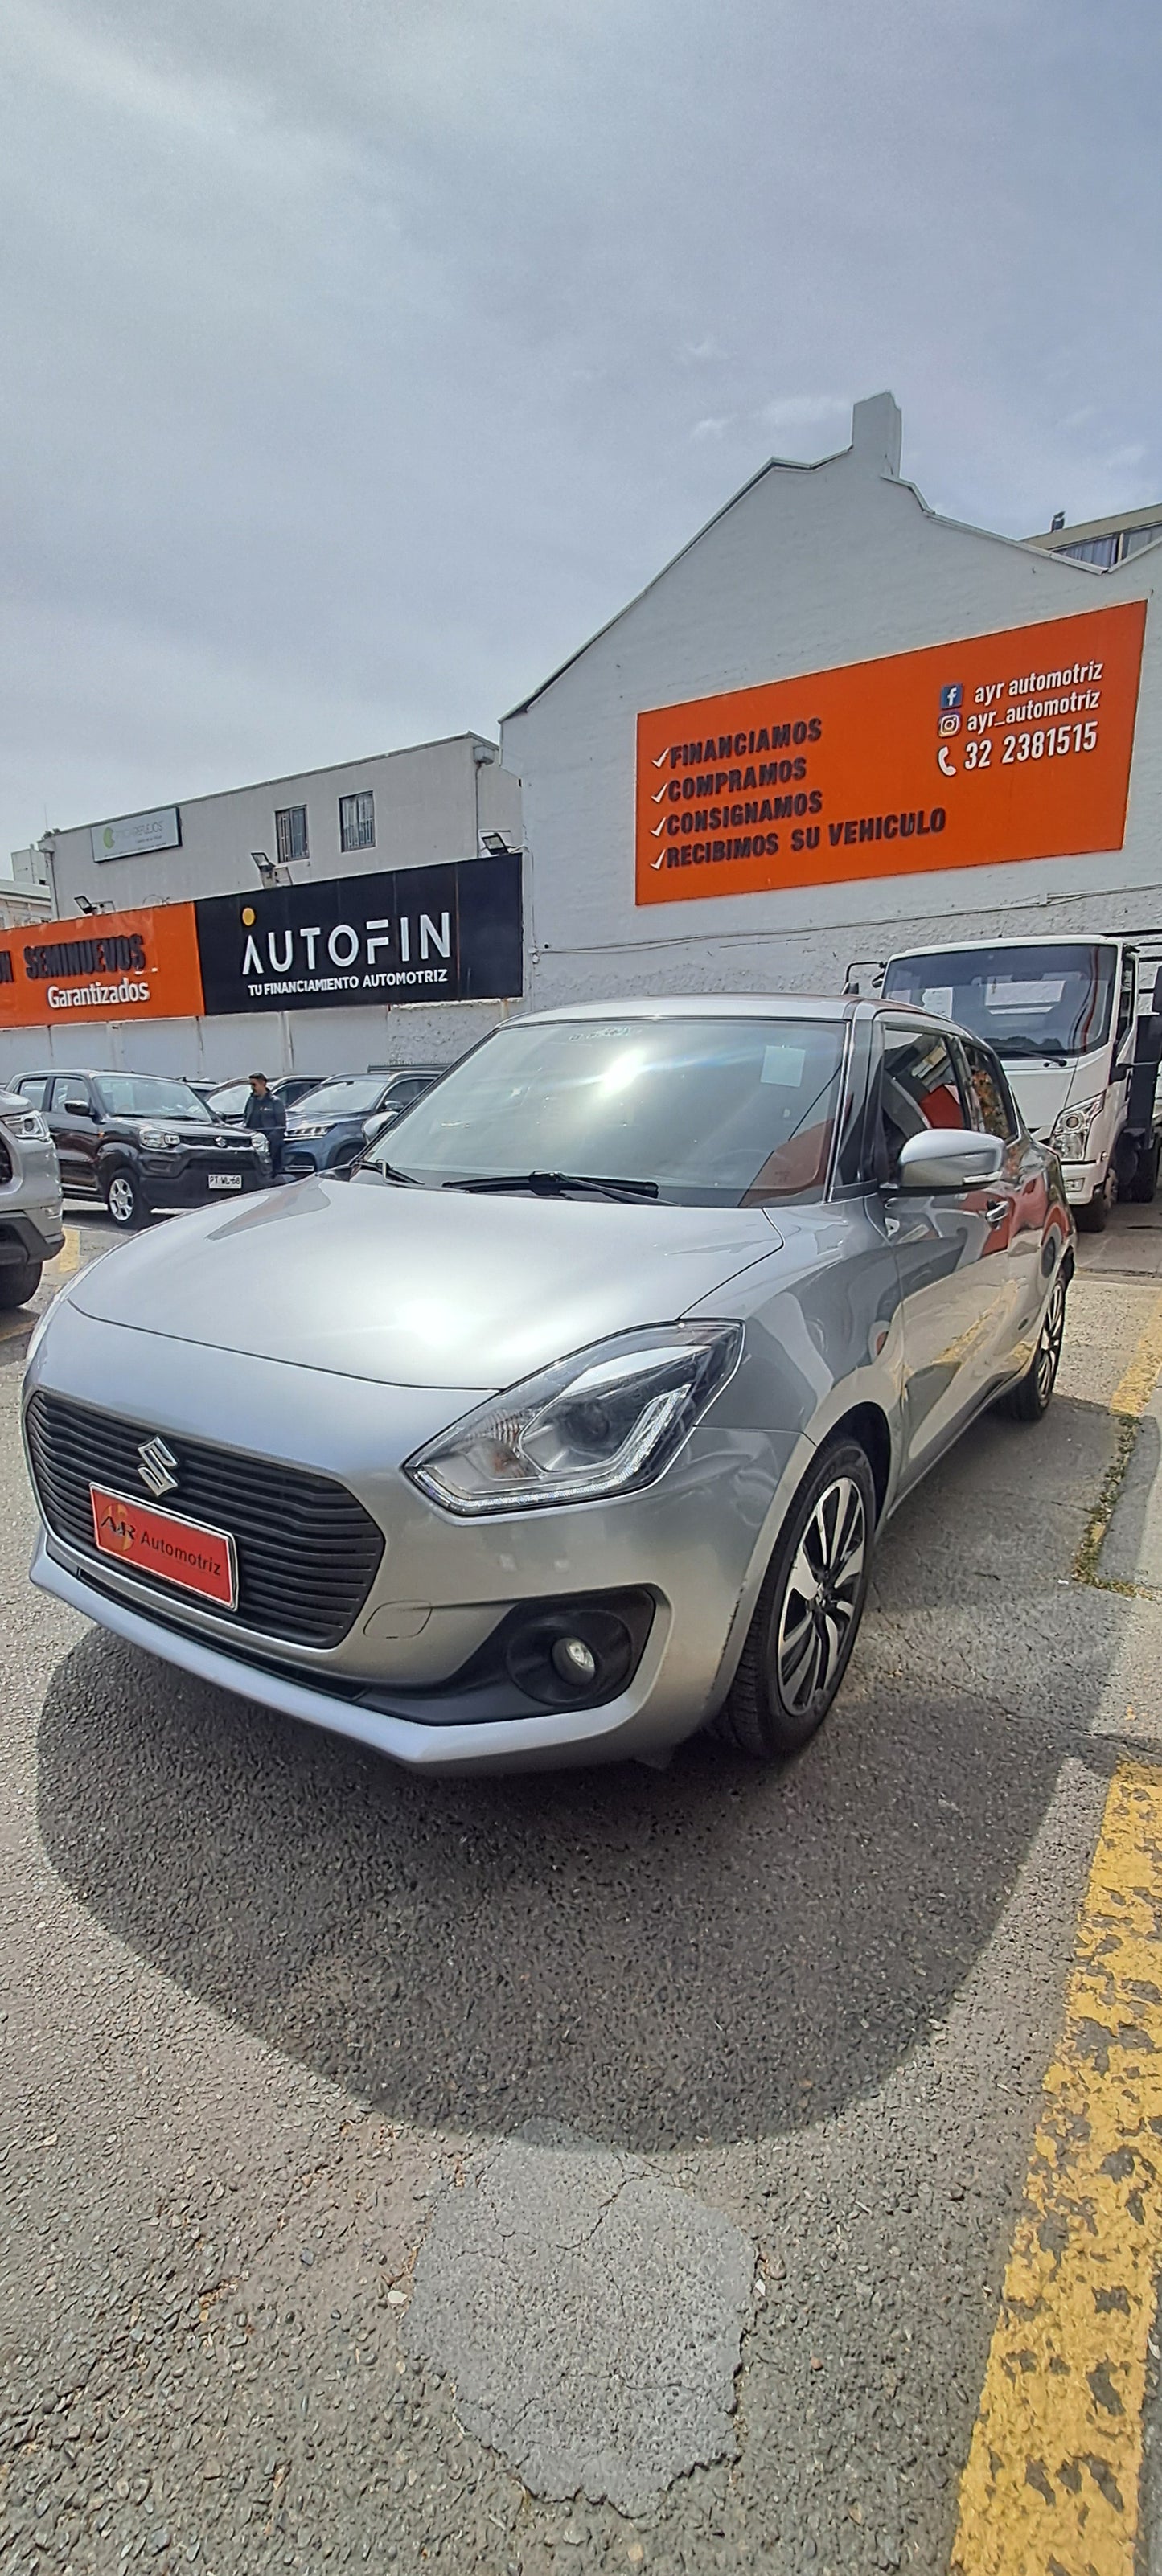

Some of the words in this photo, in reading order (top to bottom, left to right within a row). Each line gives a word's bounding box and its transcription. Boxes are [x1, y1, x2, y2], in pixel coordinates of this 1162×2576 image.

[975, 682, 1004, 706] ayr
[1008, 659, 1103, 696] automotriz
[967, 689, 1101, 735] ayr_automotriz
[670, 717, 822, 769] FINANCIAMOS
[965, 740, 992, 769] 32
[1001, 720, 1098, 764] 2381515
[667, 757, 807, 802] COMPRAMOS
[667, 790, 823, 835] CONSIGNAMOS
[667, 832, 778, 868] RECIBIMOS
[790, 826, 820, 851] SU
[828, 807, 946, 846] VEHICULO
[23, 933, 146, 979] SEMINUEVOS
[242, 912, 450, 974] AUTOFIN
[47, 977, 150, 1008] Garantizados
[248, 984, 263, 996] TU
[264, 975, 359, 995] FINANCIAMIENTO
[363, 969, 448, 987] AUTOMOTRIZ
[141, 1531, 221, 1576] Automotriz
